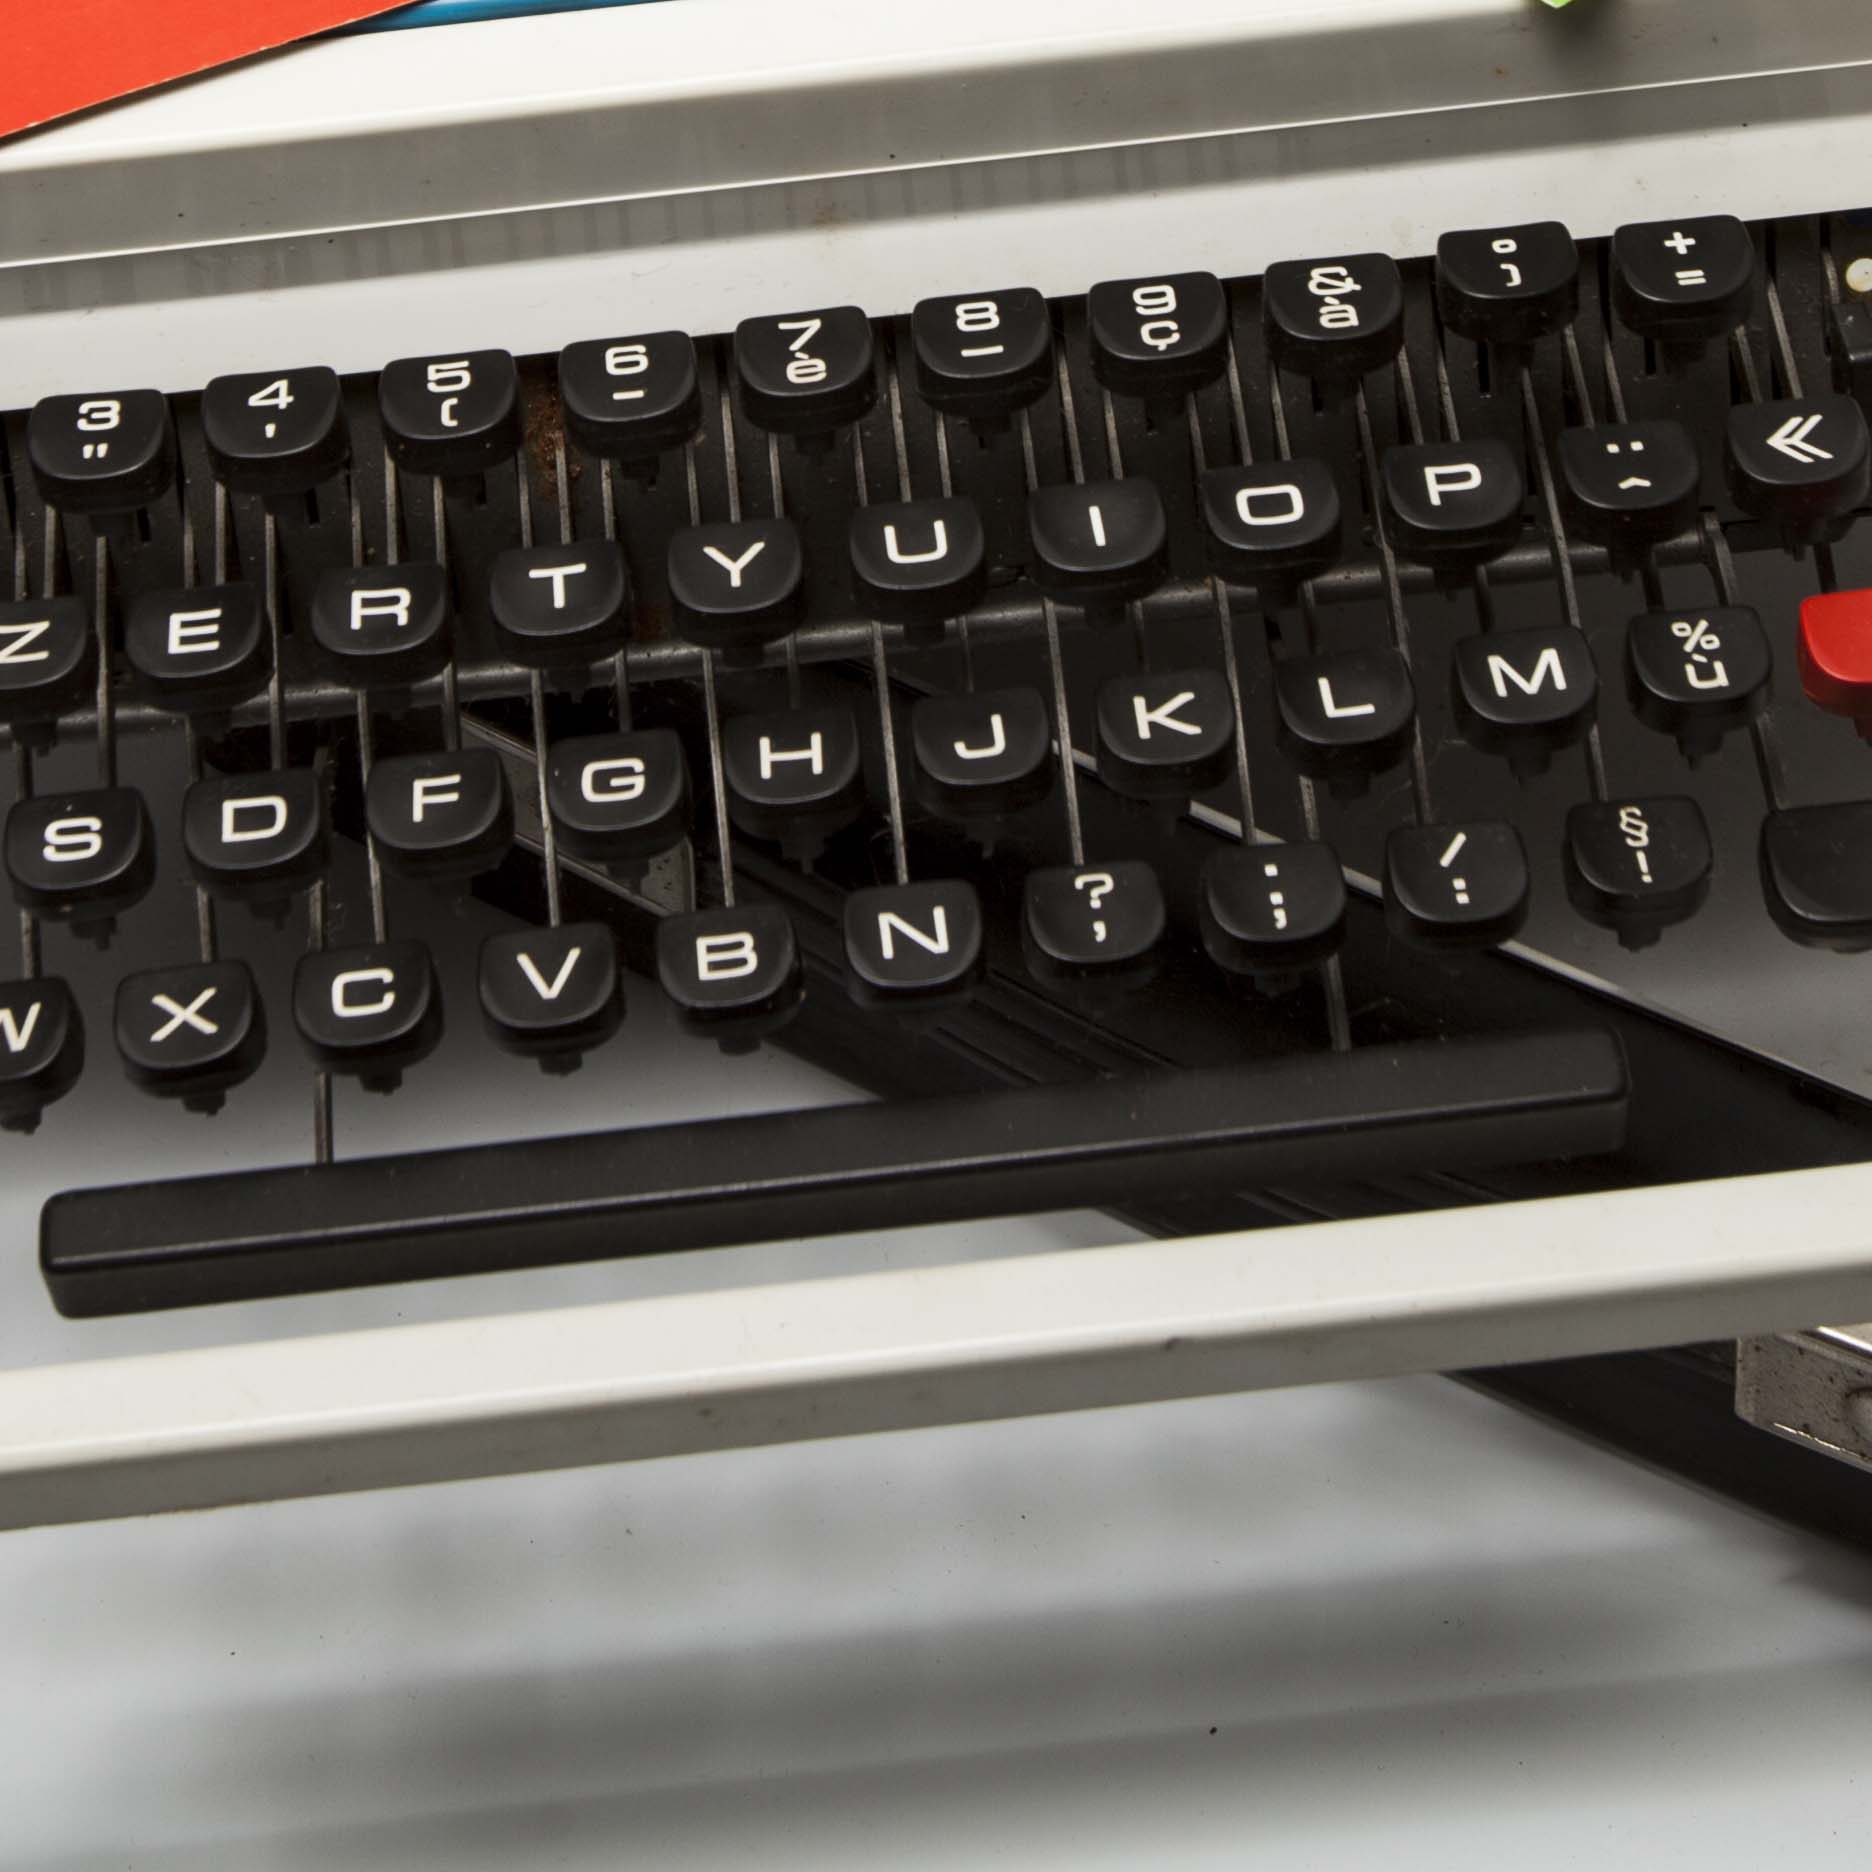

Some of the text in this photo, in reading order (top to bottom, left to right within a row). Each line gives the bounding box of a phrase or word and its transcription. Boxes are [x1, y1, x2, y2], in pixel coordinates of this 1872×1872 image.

[956, 301, 999, 331] 8
[1133, 285, 1176, 315] 9
[778, 319, 821, 351] 7
[427, 361, 471, 392] 5
[605, 345, 648, 375] 6
[77, 400, 120, 431] 3
[248, 380, 293, 409] 4
[1236, 484, 1304, 525] O
[1424, 463, 1481, 505] P
[884, 520, 947, 563] U
[1089, 506, 1105, 546] I
[529, 563, 586, 608] T
[702, 541, 765, 589] Y
[351, 588, 411, 630] R
[168, 609, 221, 654] E
[1488, 648, 1566, 697] M
[1133, 692, 1202, 739] K
[1318, 678, 1375, 718] L
[760, 733, 822, 779] H
[954, 714, 1005, 759] J
[413, 775, 460, 822] F
[581, 758, 645, 802] G
[43, 817, 101, 861] S
[222, 796, 287, 842] D
[878, 906, 949, 959] N
[517, 948, 580, 999] V
[696, 932, 757, 980] B
[151, 988, 217, 1041] X
[332, 968, 394, 1017] C
